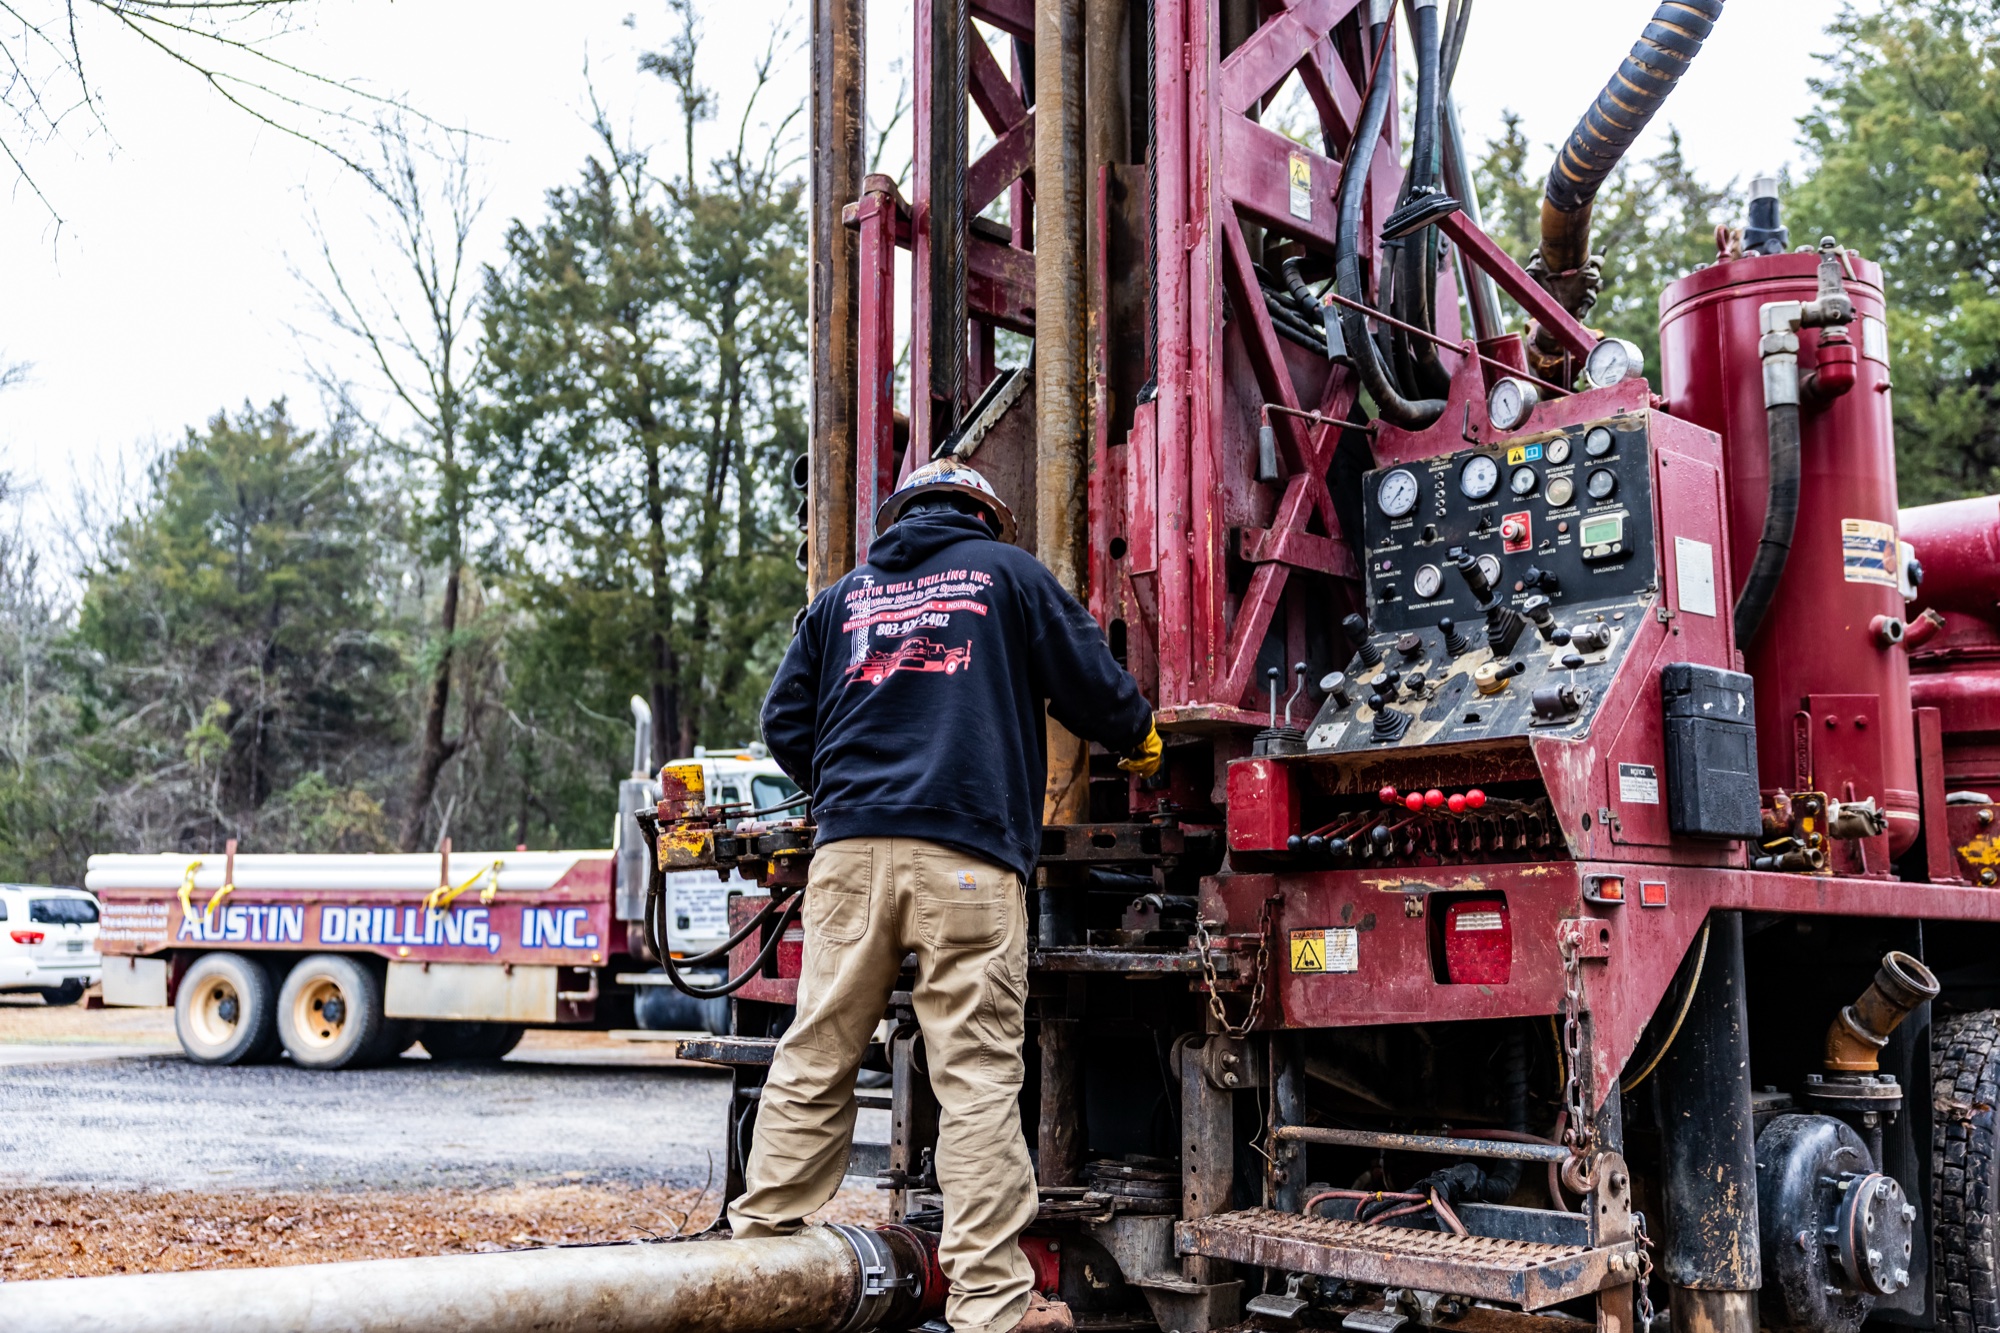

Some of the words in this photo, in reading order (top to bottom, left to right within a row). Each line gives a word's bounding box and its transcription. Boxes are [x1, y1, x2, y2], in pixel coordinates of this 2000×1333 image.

[1593, 454, 1621, 465] PRESSURE
[1428, 463, 1453, 473] BREAKERS
[1545, 463, 1576, 474] INTERSTAGE
[1547, 470, 1574, 479] PRESSURE
[1468, 501, 1499, 511] TACHOMETER
[1548, 506, 1577, 515] DISCHARGE
[1587, 502, 1624, 513] TEMPERATURE
[1545, 510, 1581, 521] TEMPERATURE
[1391, 522, 1414, 531] PRESSURE
[1373, 545, 1402, 554] COMPRESSOR
[1538, 548, 1556, 556] LIGHTS
[1593, 564, 1625, 574] DIAGNOSTIC
[845, 585, 883, 604] AUSTIN
[886, 580, 914, 594] WELL
[916, 569, 967, 589] DRILLING
[970, 570, 994, 587] INC.
[1512, 592, 1529, 600] FILTER
[1408, 602, 1430, 610] ROTATION
[1430, 598, 1455, 607] PRESSURE
[843, 614, 883, 631] RESIDENTIAL
[946, 602, 986, 613] INDUSTRIAL
[101, 903, 169, 915] Commercial
[101, 917, 167, 928] Residential
[100, 928, 168, 940] Geothermal
[177, 904, 304, 942] AUSTIN
[319, 906, 501, 954] DRILLING,
[522, 907, 598, 949] INC.
